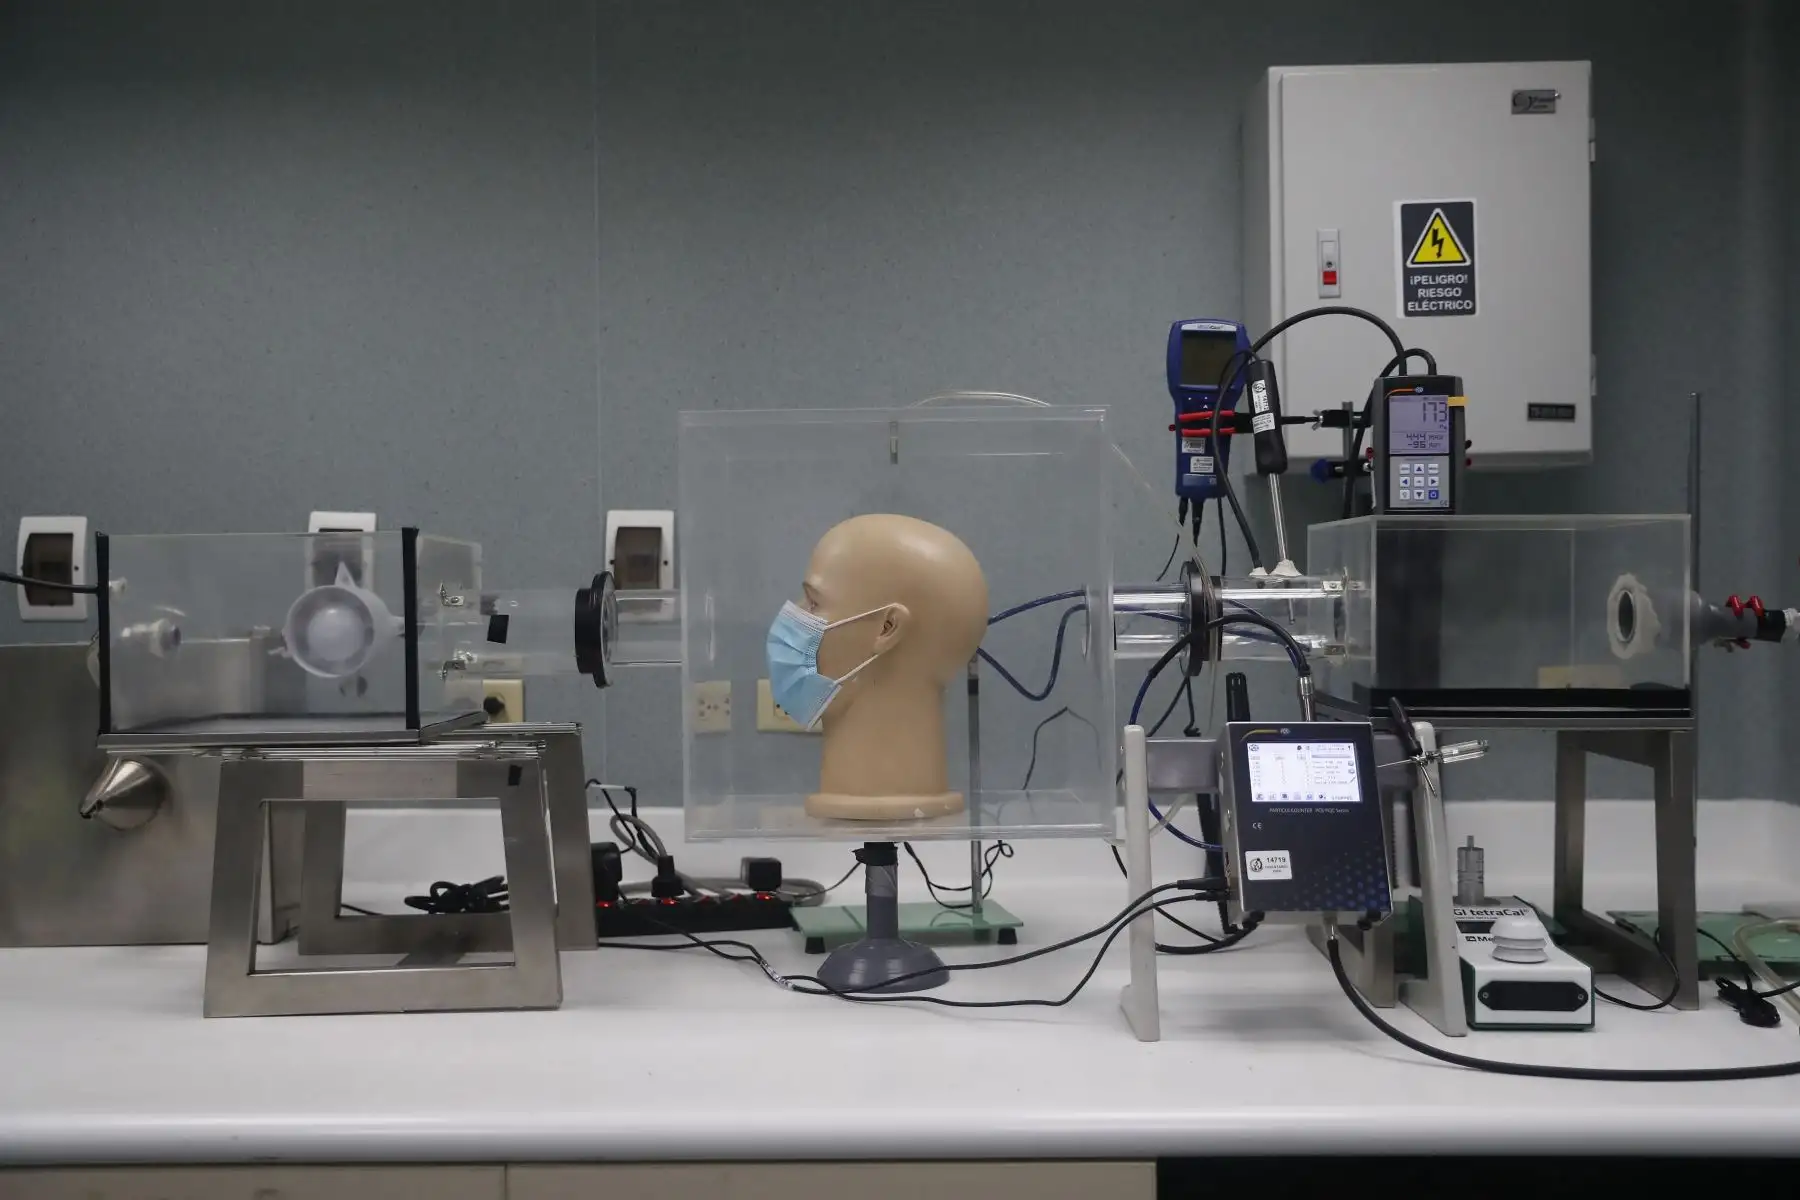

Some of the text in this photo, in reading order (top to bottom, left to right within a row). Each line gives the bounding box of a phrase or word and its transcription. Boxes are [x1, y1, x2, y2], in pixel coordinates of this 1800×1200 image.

[1409, 273, 1468, 286] ¡PELIGRO!
[1417, 286, 1462, 298] RIESGO
[1407, 298, 1474, 311] ELÉCTRICO
[1422, 401, 1447, 423] 173
[1252, 822, 1262, 830] CE
